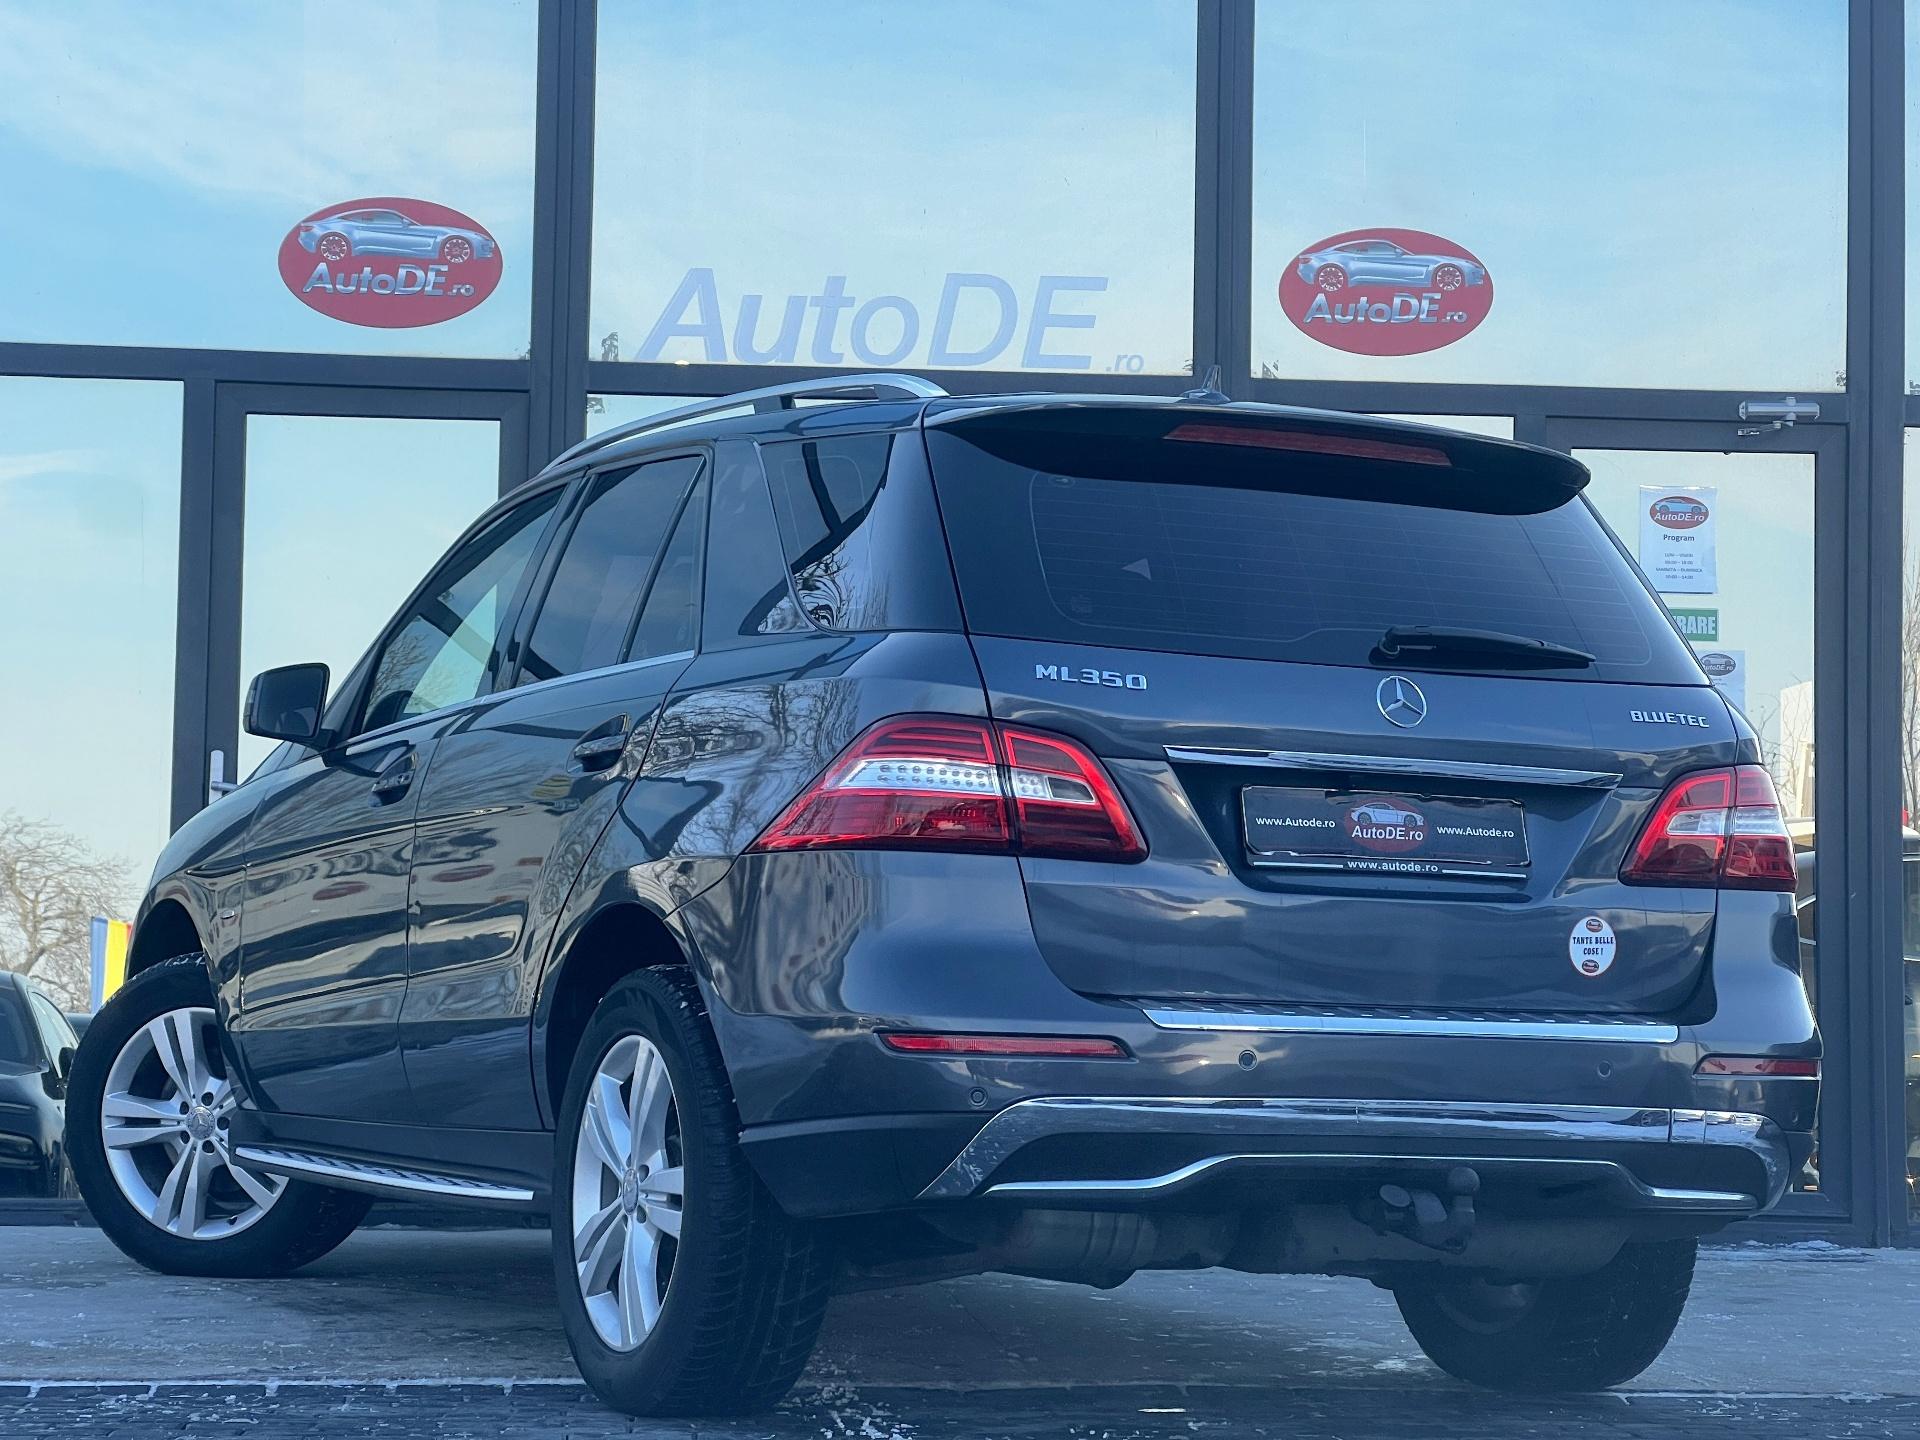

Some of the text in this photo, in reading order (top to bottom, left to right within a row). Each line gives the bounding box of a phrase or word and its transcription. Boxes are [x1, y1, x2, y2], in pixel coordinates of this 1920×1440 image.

[303, 262, 475, 297] AutoDE.ro
[1304, 292, 1468, 324] AutoDE.ro
[1654, 512, 1705, 522] AutoDE.ro
[1663, 533, 1695, 542] Program
[1035, 664, 1148, 690] ML350
[1630, 710, 1710, 728] BLUETEC
[1255, 817, 1336, 828] www.Autode.ro
[1351, 825, 1424, 841] AutoDE.ro
[1437, 826, 1515, 838] www.Autode.ro
[1347, 861, 1438, 872] www.autode.ro
[1572, 936, 1614, 945] TANTE BELLE
[1583, 947, 1600, 956] COSE
